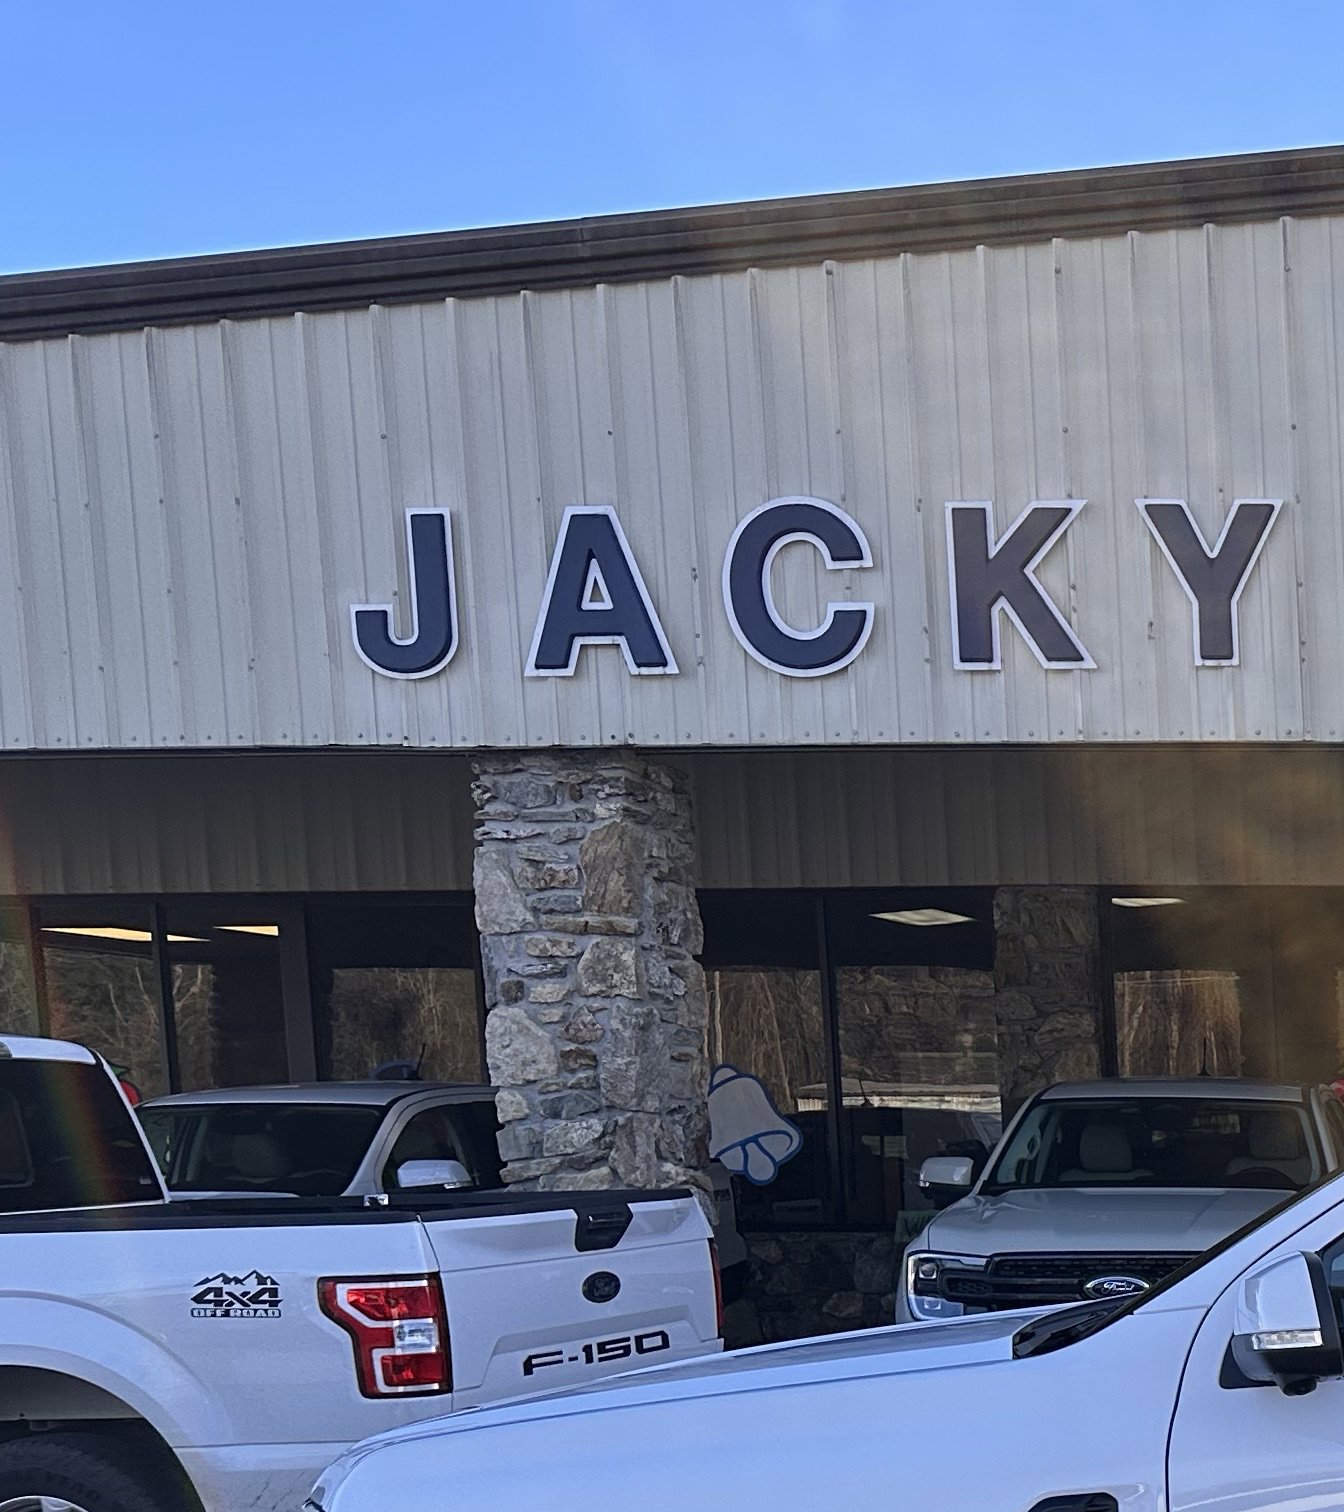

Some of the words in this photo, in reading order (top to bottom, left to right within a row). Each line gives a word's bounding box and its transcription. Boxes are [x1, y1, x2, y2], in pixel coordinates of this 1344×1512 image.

[350, 496, 1284, 680] JACKY
[190, 1287, 284, 1308] 4x4
[192, 1308, 226, 1318] OFF
[229, 1308, 281, 1318] ROAD
[523, 1330, 670, 1376] F-150
